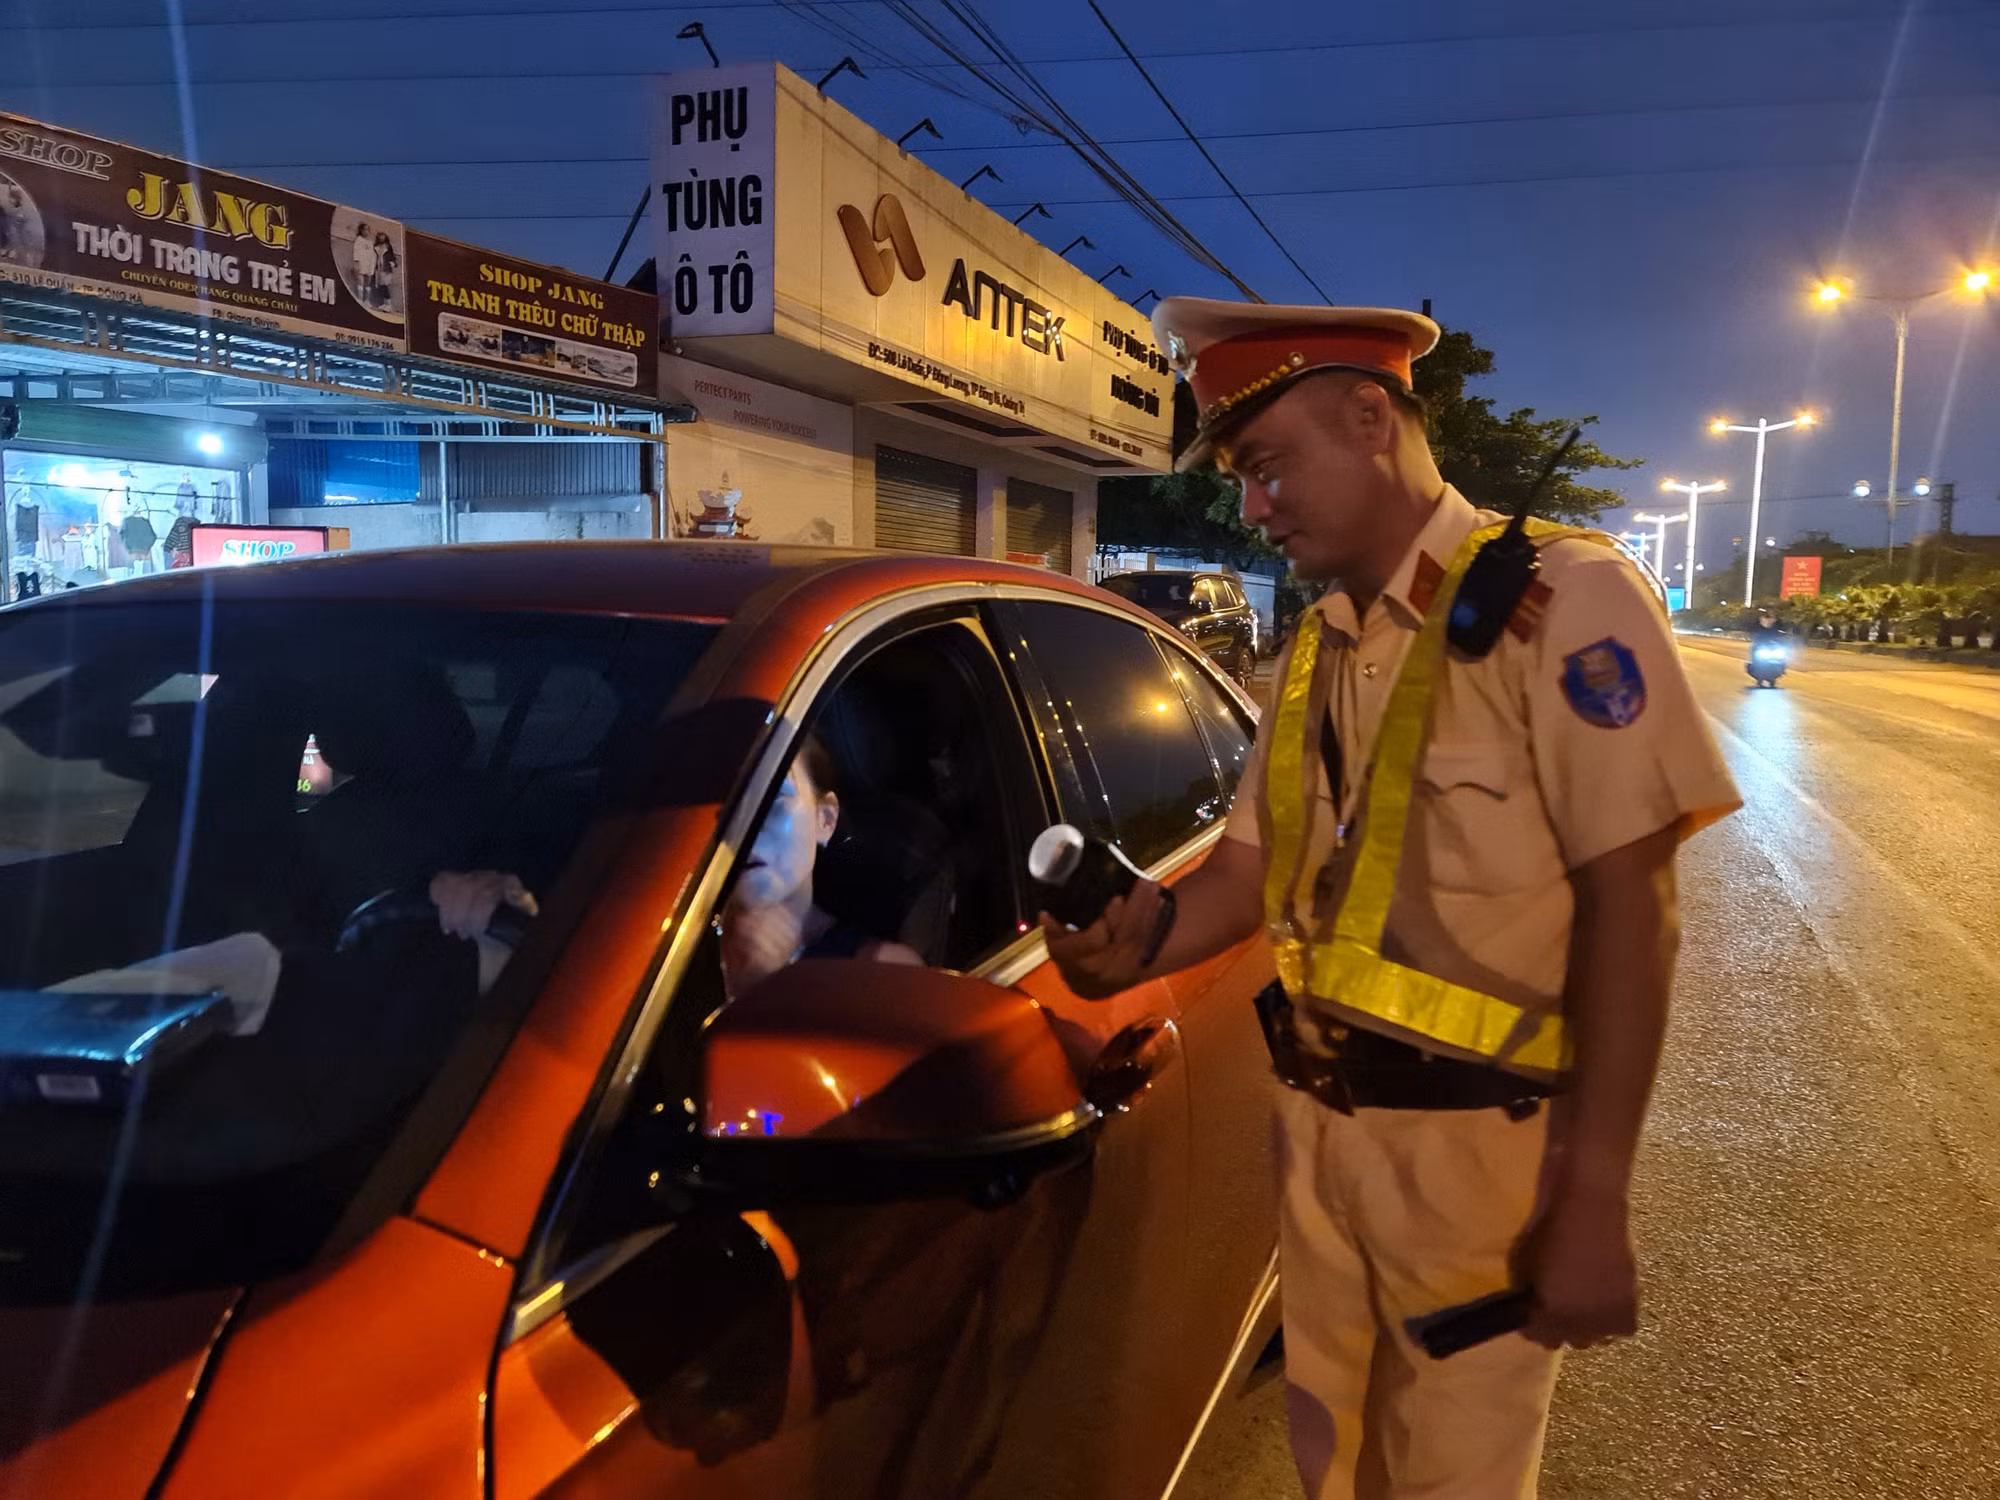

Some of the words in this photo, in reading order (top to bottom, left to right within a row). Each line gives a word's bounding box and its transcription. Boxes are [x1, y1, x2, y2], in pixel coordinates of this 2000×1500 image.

[0, 128, 112, 173] SHOP
[671, 86, 748, 152] PHỤ
[126, 172, 294, 250] JANG
[662, 167, 762, 232] TÙNG
[71, 221, 143, 265] THỜI
[150, 238, 241, 284] TRANG
[248, 258, 294, 297] TRẺ
[299, 272, 336, 306] EM
[121, 270, 167, 287] CHUYÊN
[479, 263, 543, 294] SHOP
[547, 282, 605, 310] JANG
[675, 252, 698, 316] Ô
[708, 249, 754, 314] TÔ
[426, 280, 501, 316] TRANH
[505, 300, 556, 328] THÊU
[561, 313, 599, 338] CHỮ
[602, 323, 645, 350] THẬP
[223, 540, 296, 560] SHOP
